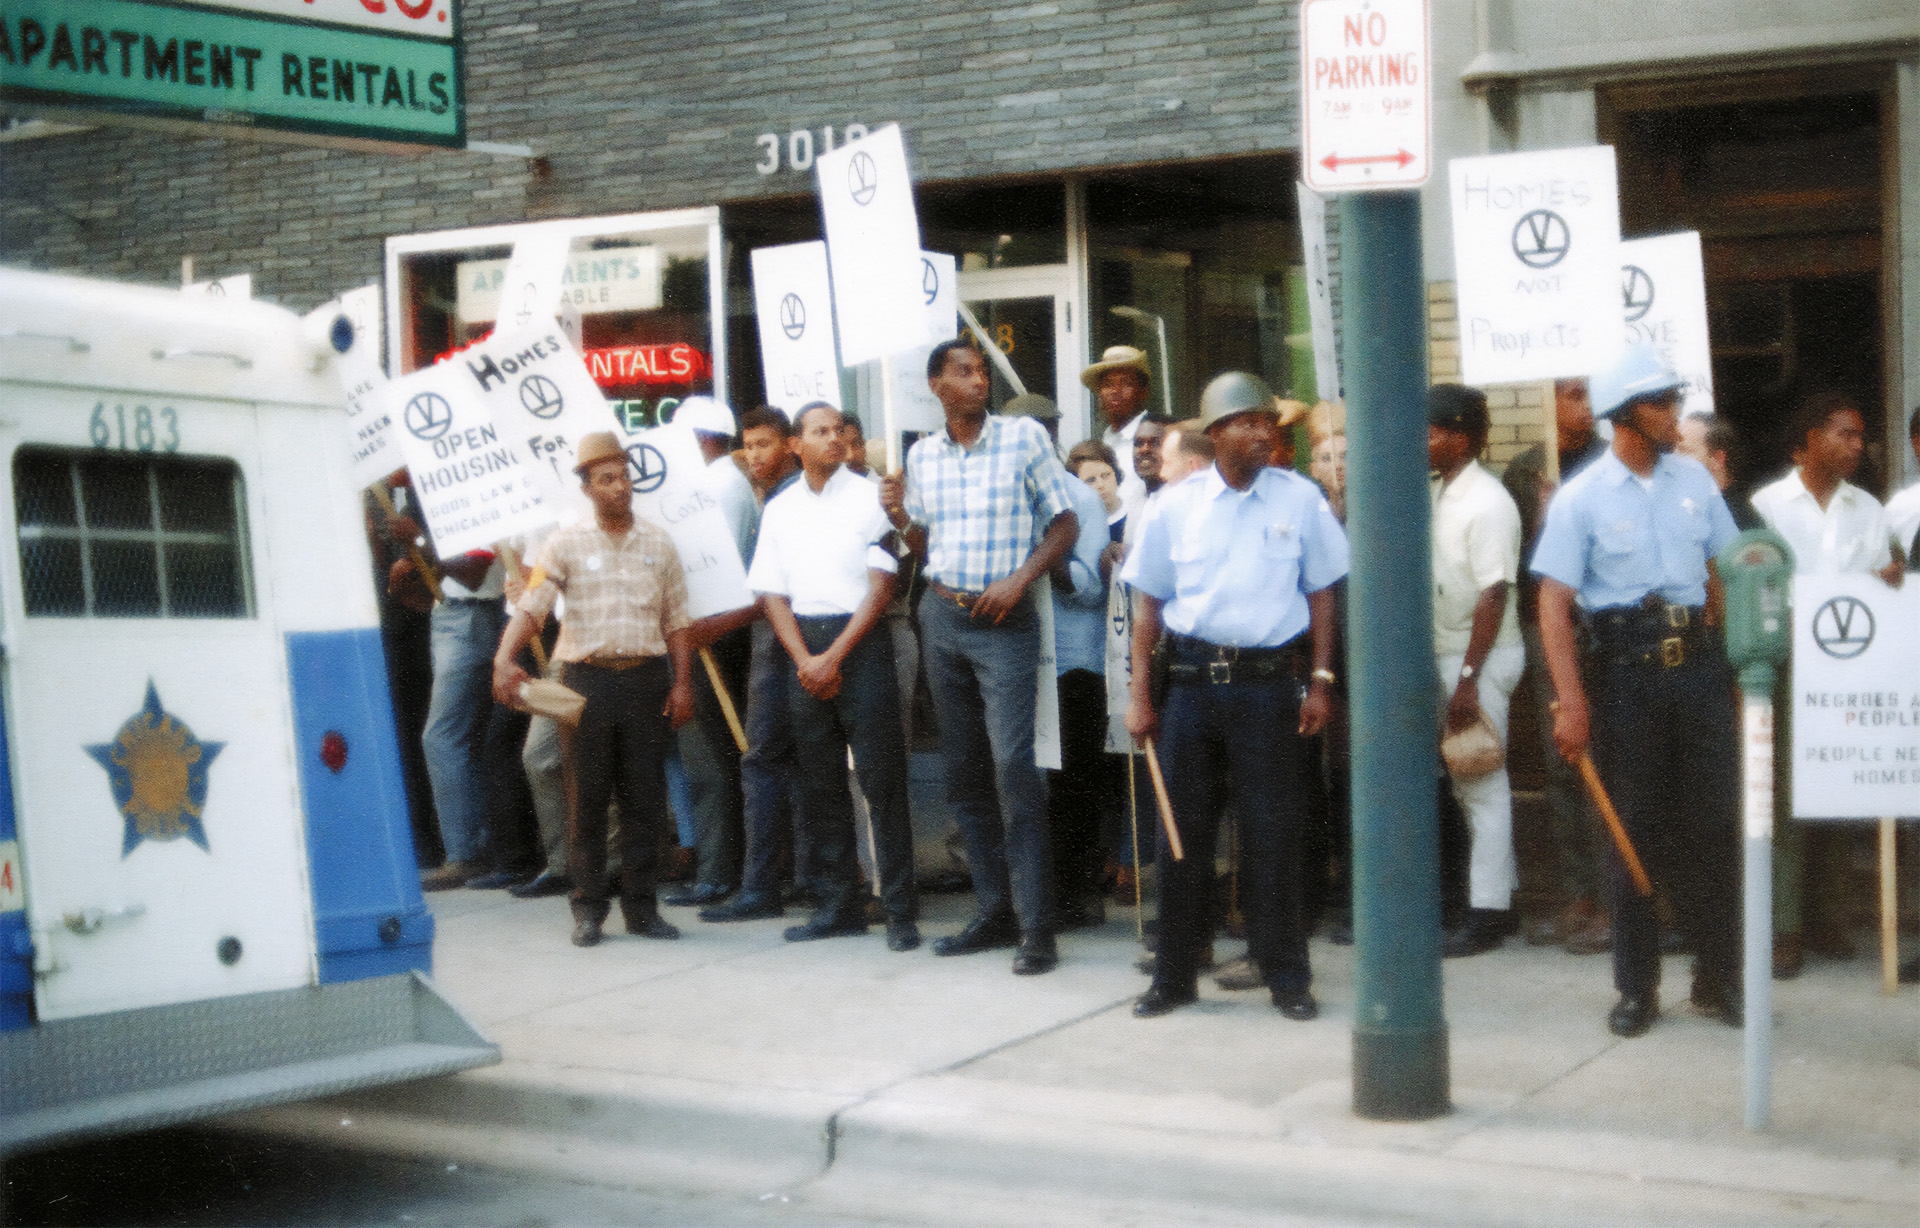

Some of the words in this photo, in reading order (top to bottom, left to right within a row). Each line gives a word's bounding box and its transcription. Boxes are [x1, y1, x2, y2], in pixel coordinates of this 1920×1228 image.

[1344, 12, 1387, 48] NO
[0, 15, 261, 91] APARTMENT
[282, 53, 450, 114] RENTALS
[1315, 52, 1418, 91] PARKING
[466, 335, 561, 392] HOMES
[89, 401, 181, 453] 6183
[432, 422, 498, 460] OPEN
[528, 435, 567, 460] FOR
[434, 508, 500, 539] CHICAGO
[510, 496, 541, 514] LAW
[1806, 691, 1899, 708] NEGROES
[1806, 746, 1882, 762] PEOPLE
[1896, 746, 1919, 762] NE
[1854, 769, 1920, 785] HOMES
